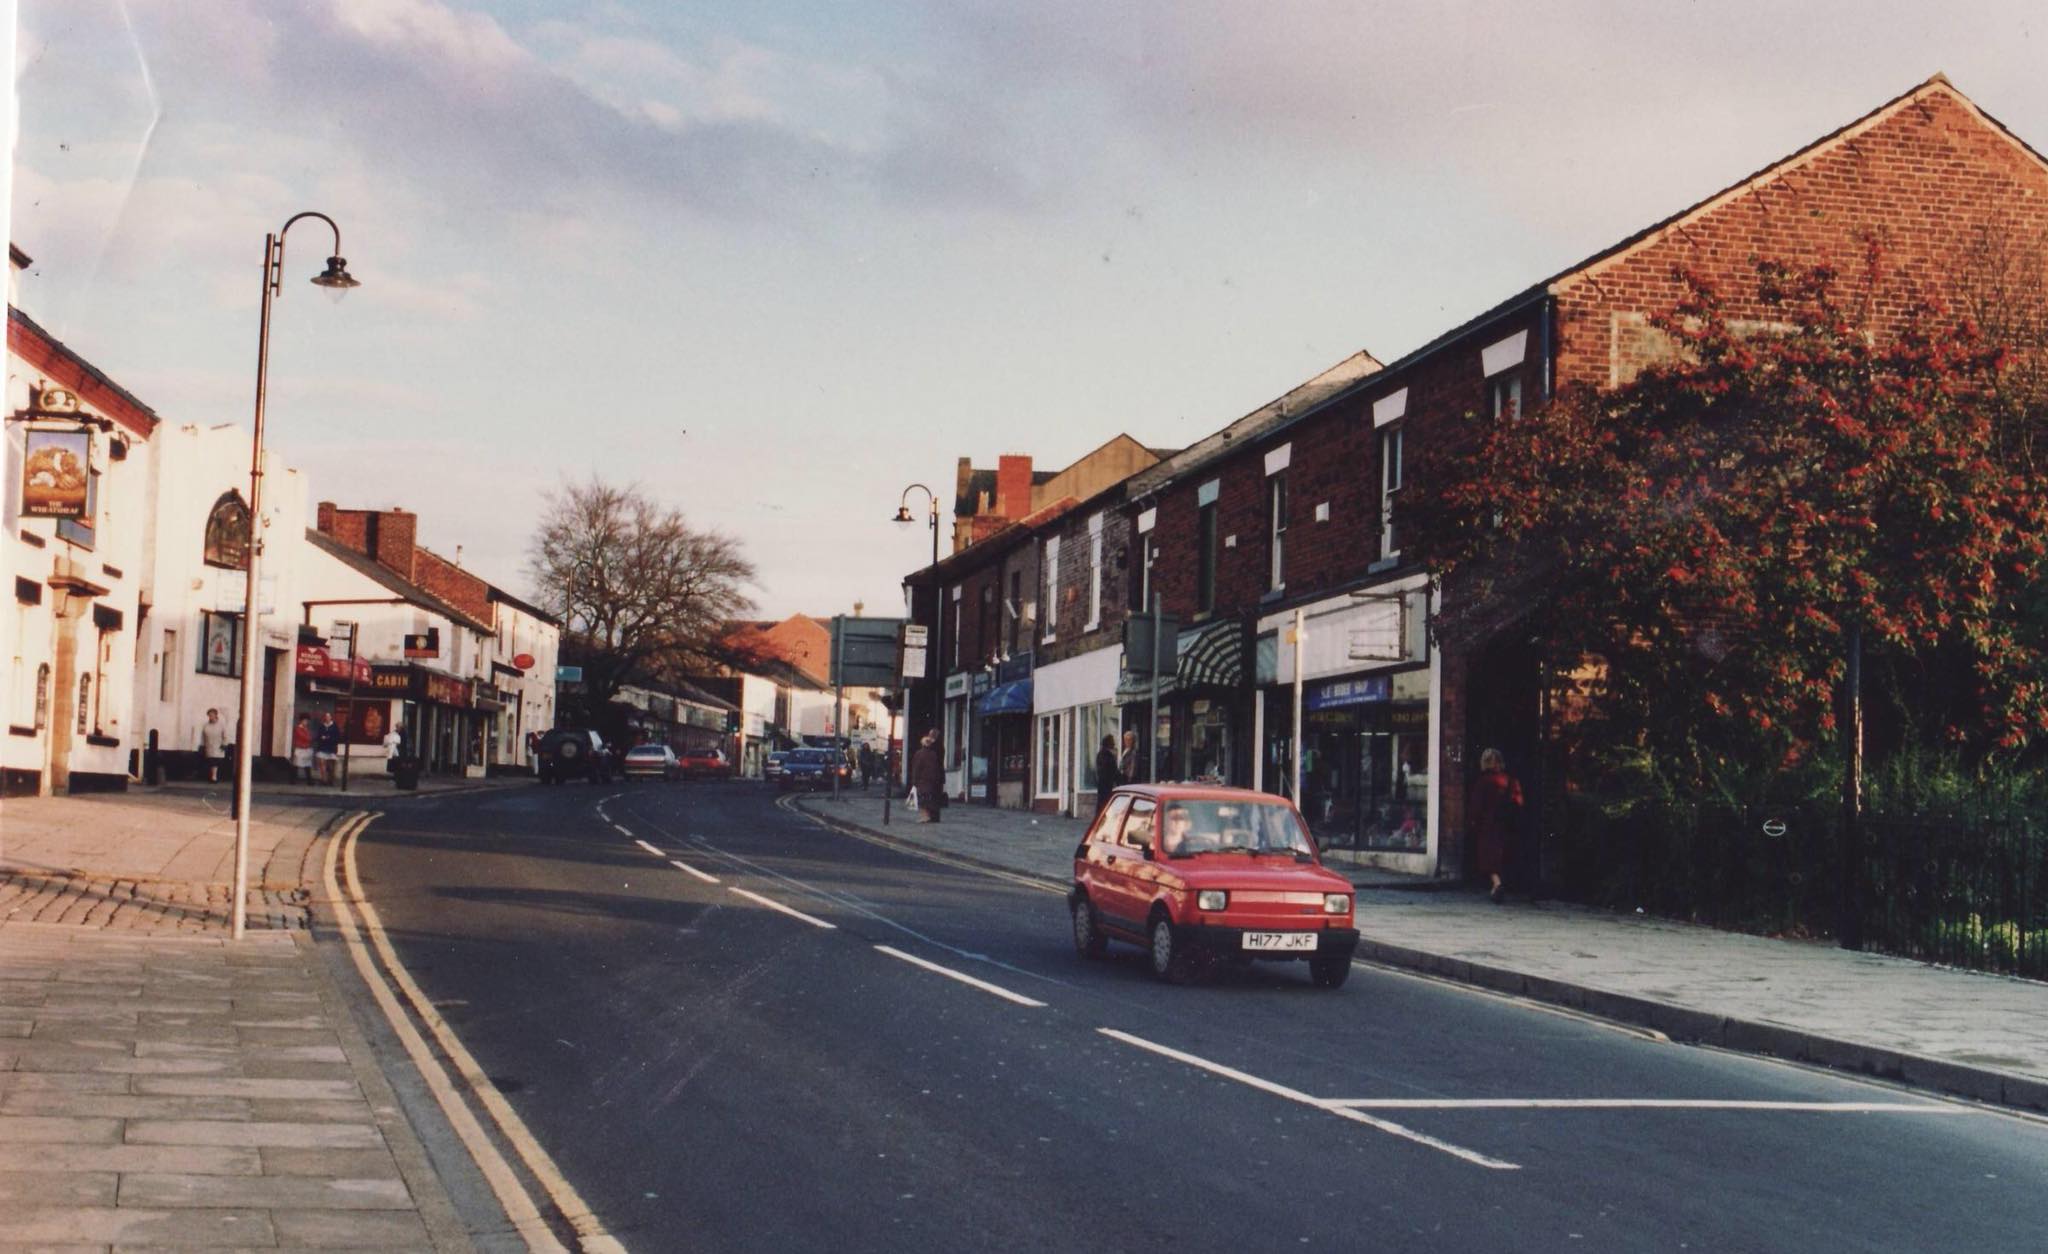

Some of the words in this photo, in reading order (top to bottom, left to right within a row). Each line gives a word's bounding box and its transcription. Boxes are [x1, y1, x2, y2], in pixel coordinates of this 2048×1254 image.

[376, 674, 408, 687] CABIN
[1249, 934, 1282, 947] H177
[1286, 935, 1312, 947] JKF
